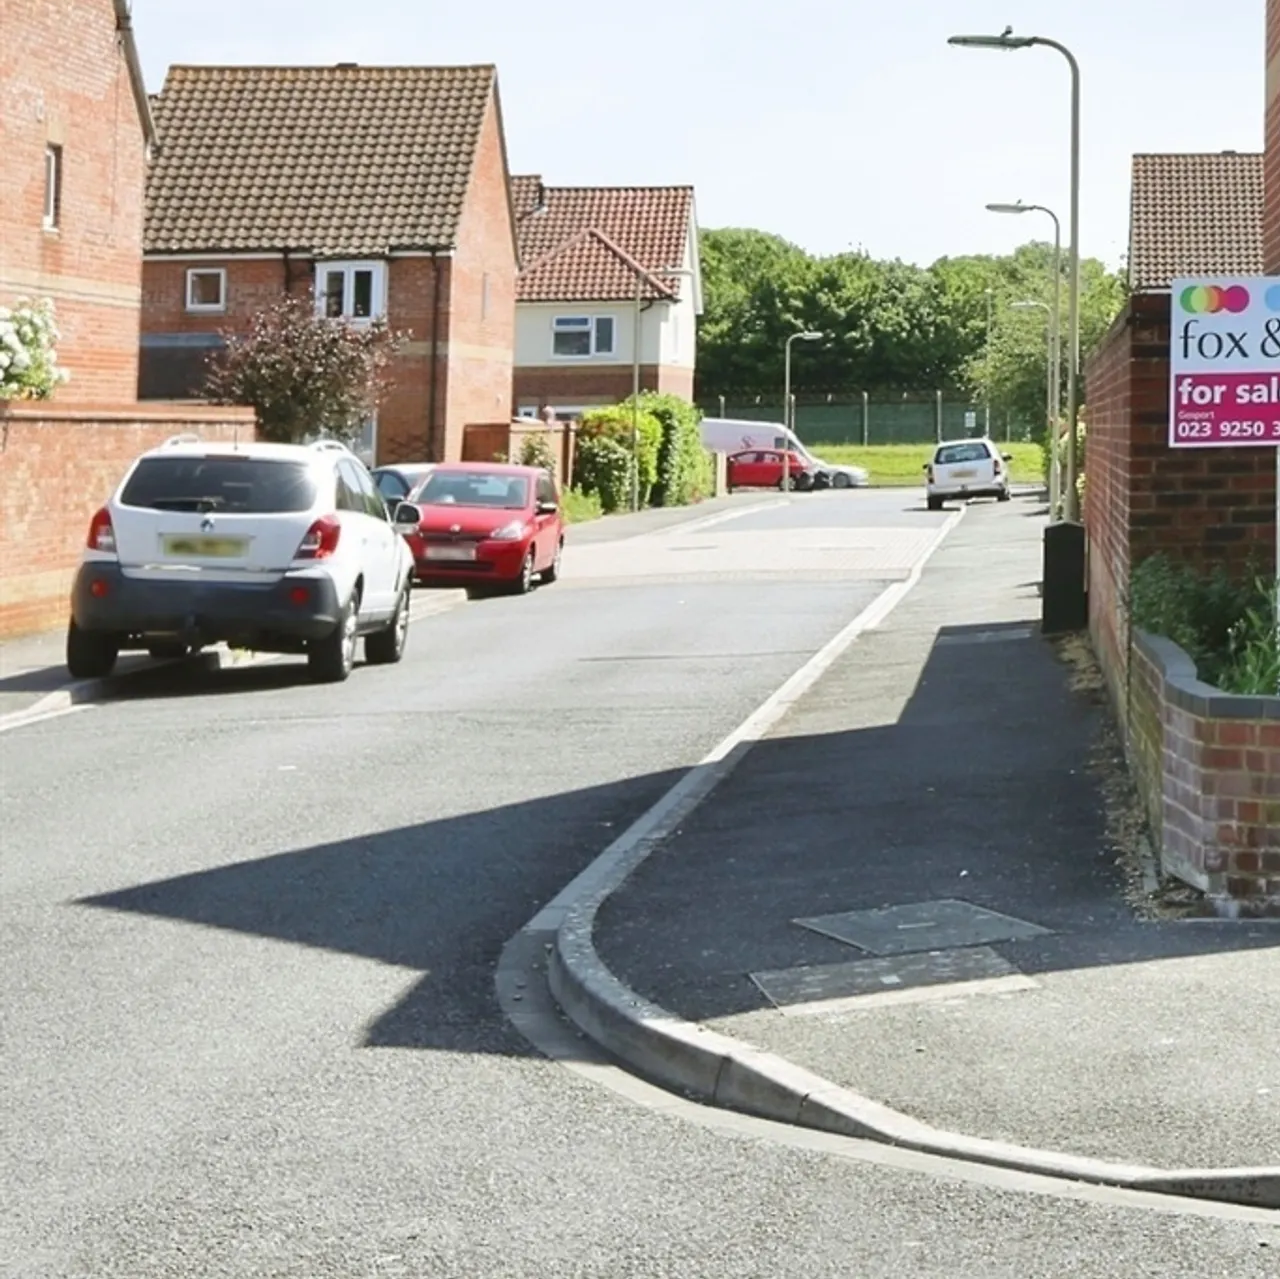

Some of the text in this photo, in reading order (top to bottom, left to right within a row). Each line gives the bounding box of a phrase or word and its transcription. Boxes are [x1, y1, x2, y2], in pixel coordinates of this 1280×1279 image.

[1179, 319, 1249, 359] fox
[1178, 377, 1227, 404] for
[1177, 422, 1212, 437] 023
[1219, 421, 1265, 437] 9250
